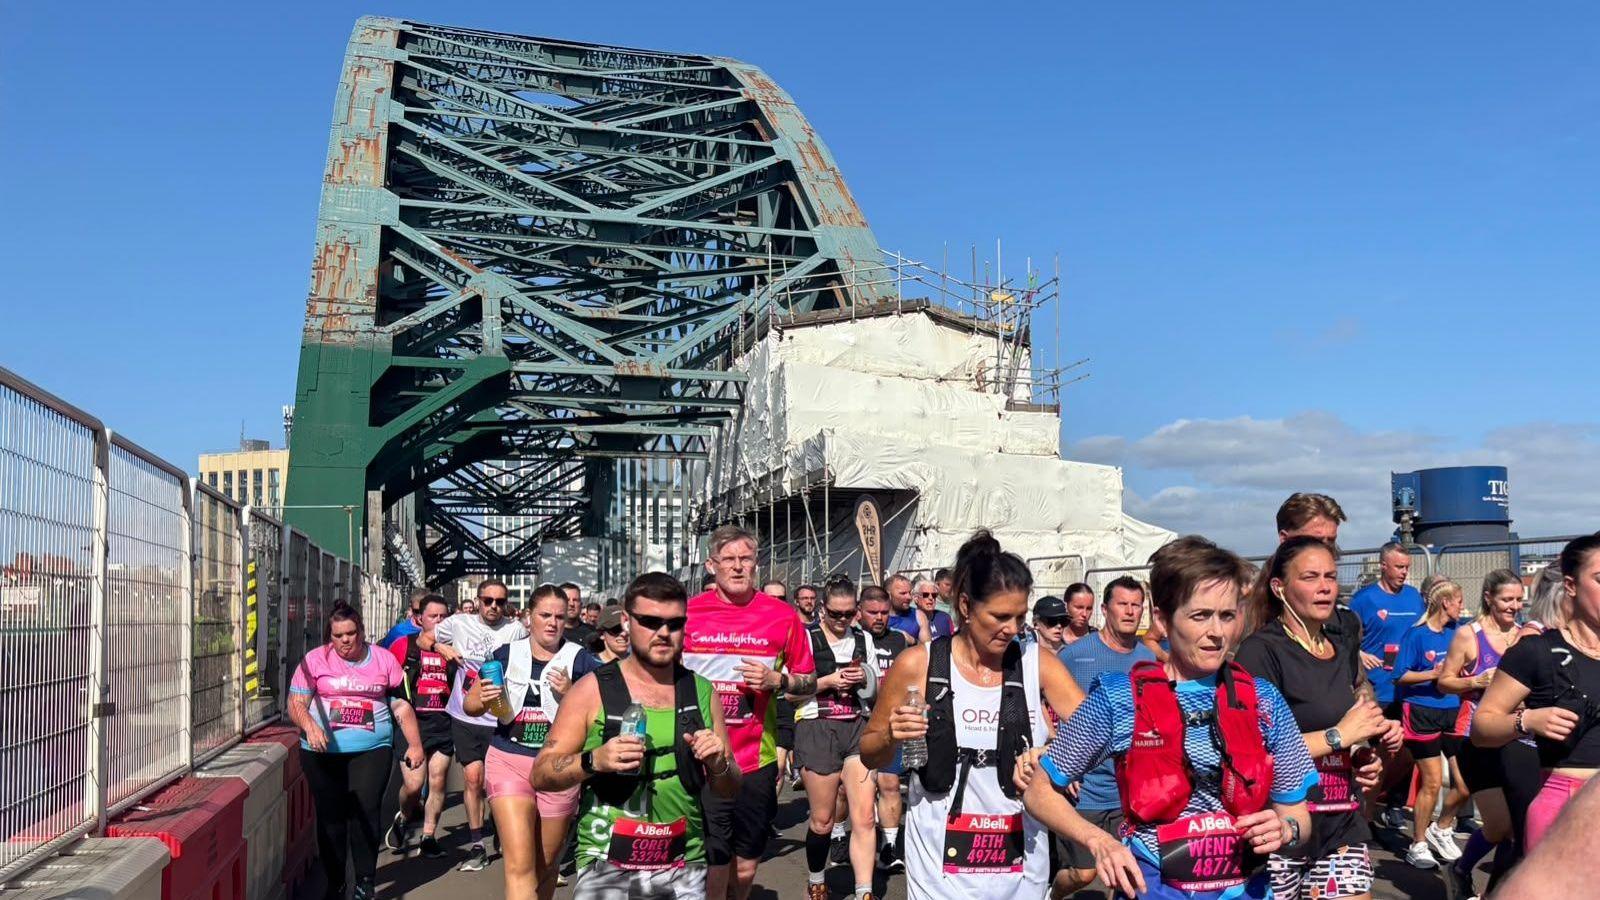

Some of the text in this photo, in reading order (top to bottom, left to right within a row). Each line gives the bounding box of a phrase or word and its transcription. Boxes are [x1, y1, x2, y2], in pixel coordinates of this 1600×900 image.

[691, 632, 769, 647] Candlelighters
[1135, 739, 1164, 747] HARRIER
[634, 824, 672, 836] AJBell.
[969, 817, 1009, 830] AJBell.
[631, 838, 671, 851] COREY
[972, 834, 1004, 848] BETH
[629, 850, 669, 862] 53294
[967, 849, 1007, 864] 49744
[1181, 882, 1203, 890] GREAT
